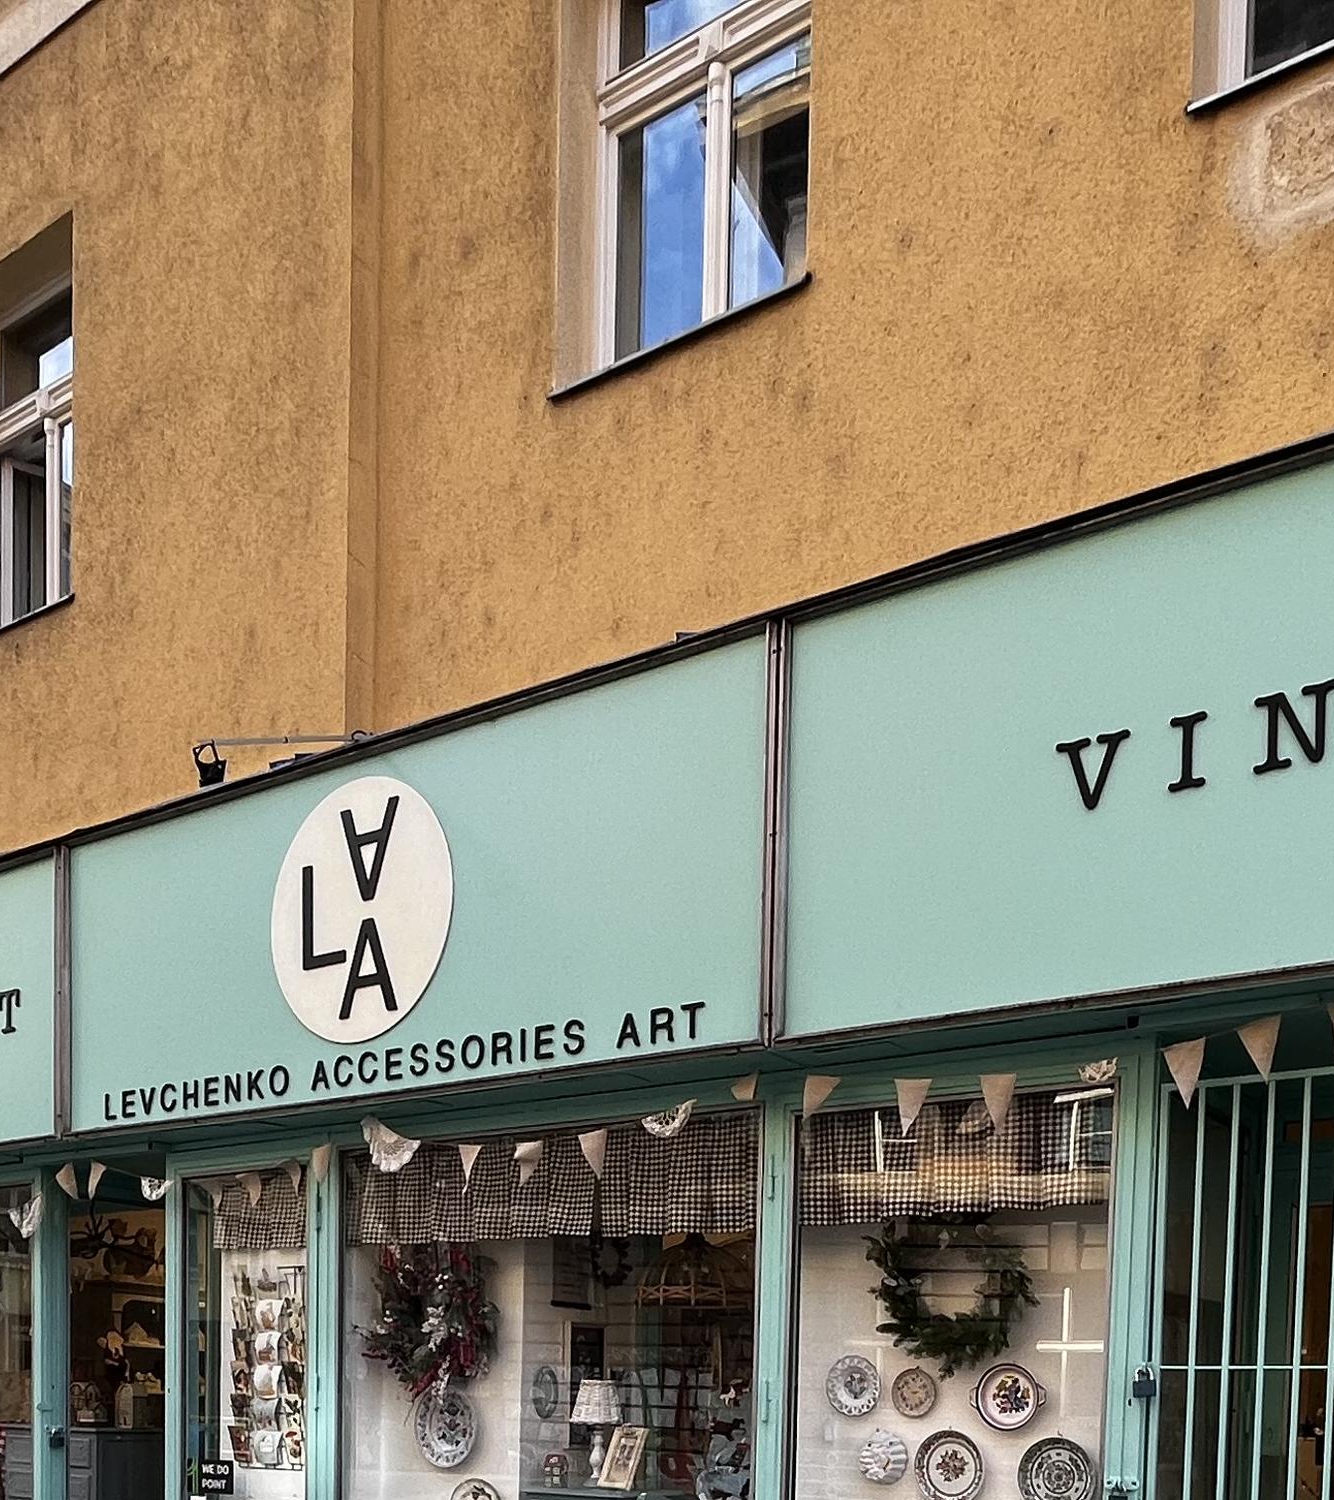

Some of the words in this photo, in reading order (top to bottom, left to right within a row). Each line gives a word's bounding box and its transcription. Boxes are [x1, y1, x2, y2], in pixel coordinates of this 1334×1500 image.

[104, 1065, 290, 1121] LEVCHENKO
[310, 1019, 586, 1092] ACCESSORIES
[616, 1001, 706, 1049] ART
[202, 1464, 216, 1474] WE
[217, 1464, 229, 1475] DO
[202, 1479, 227, 1490] POINT
